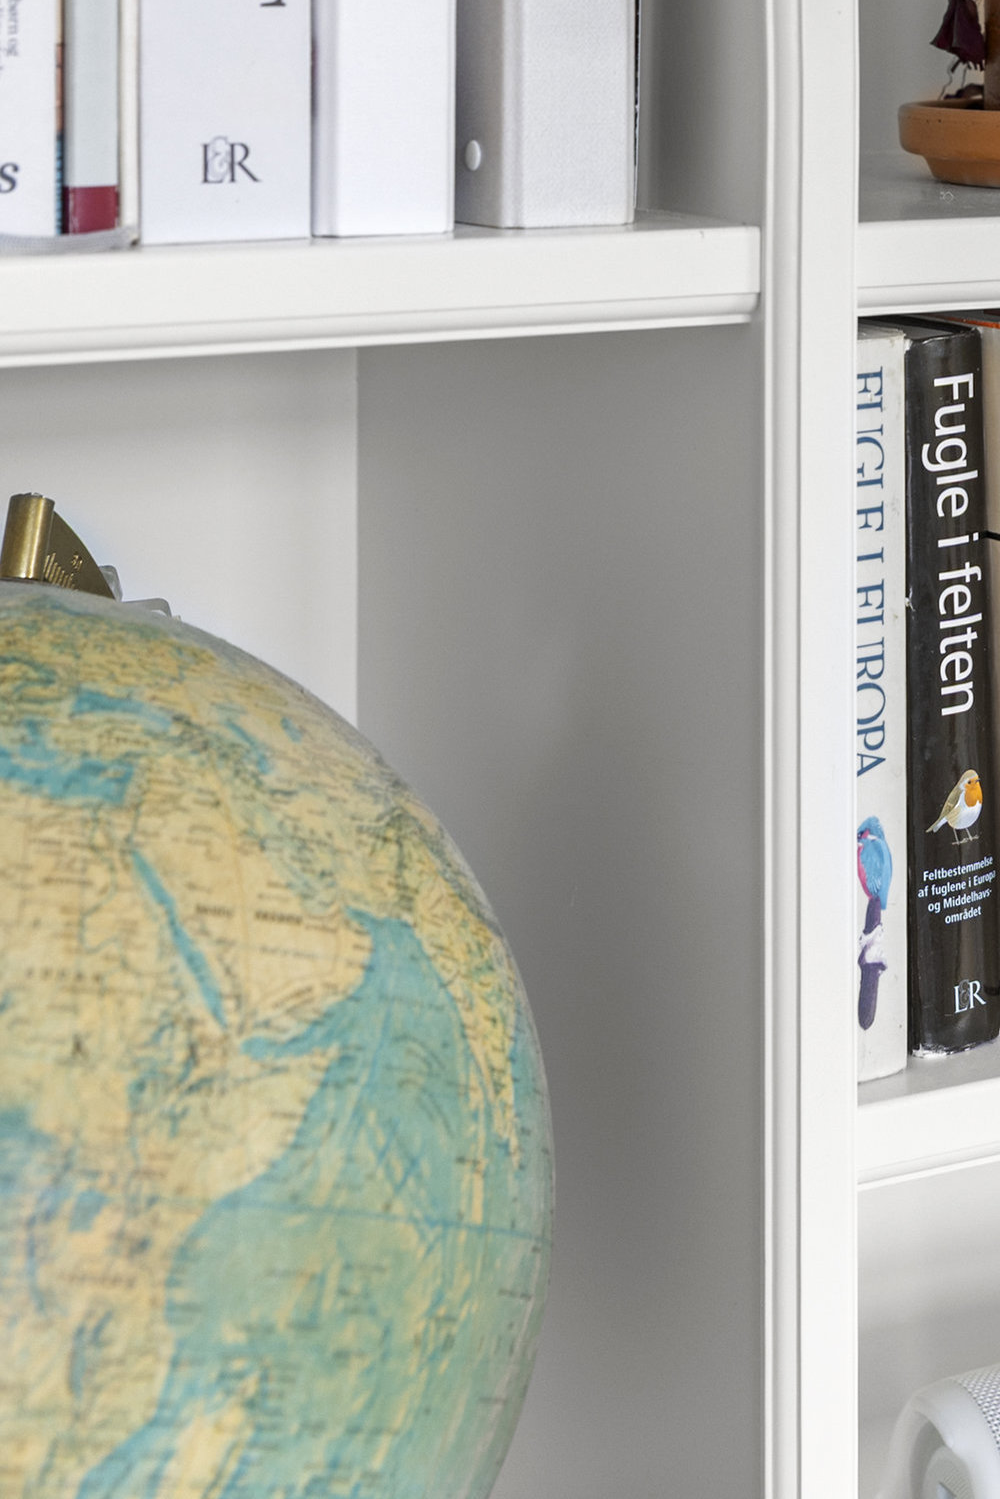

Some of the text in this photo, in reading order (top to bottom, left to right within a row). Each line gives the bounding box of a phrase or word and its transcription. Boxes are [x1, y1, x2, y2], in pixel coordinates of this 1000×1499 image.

[921, 372, 984, 717] Fugle i felten
[923, 855, 994, 882] Feltbestemmelse
[917, 885, 928, 899] af
[931, 880, 967, 898] fuglene
[973, 870, 996, 887] Europa
[927, 888, 992, 914] og Middelhavs-
[945, 905, 982, 924] området
